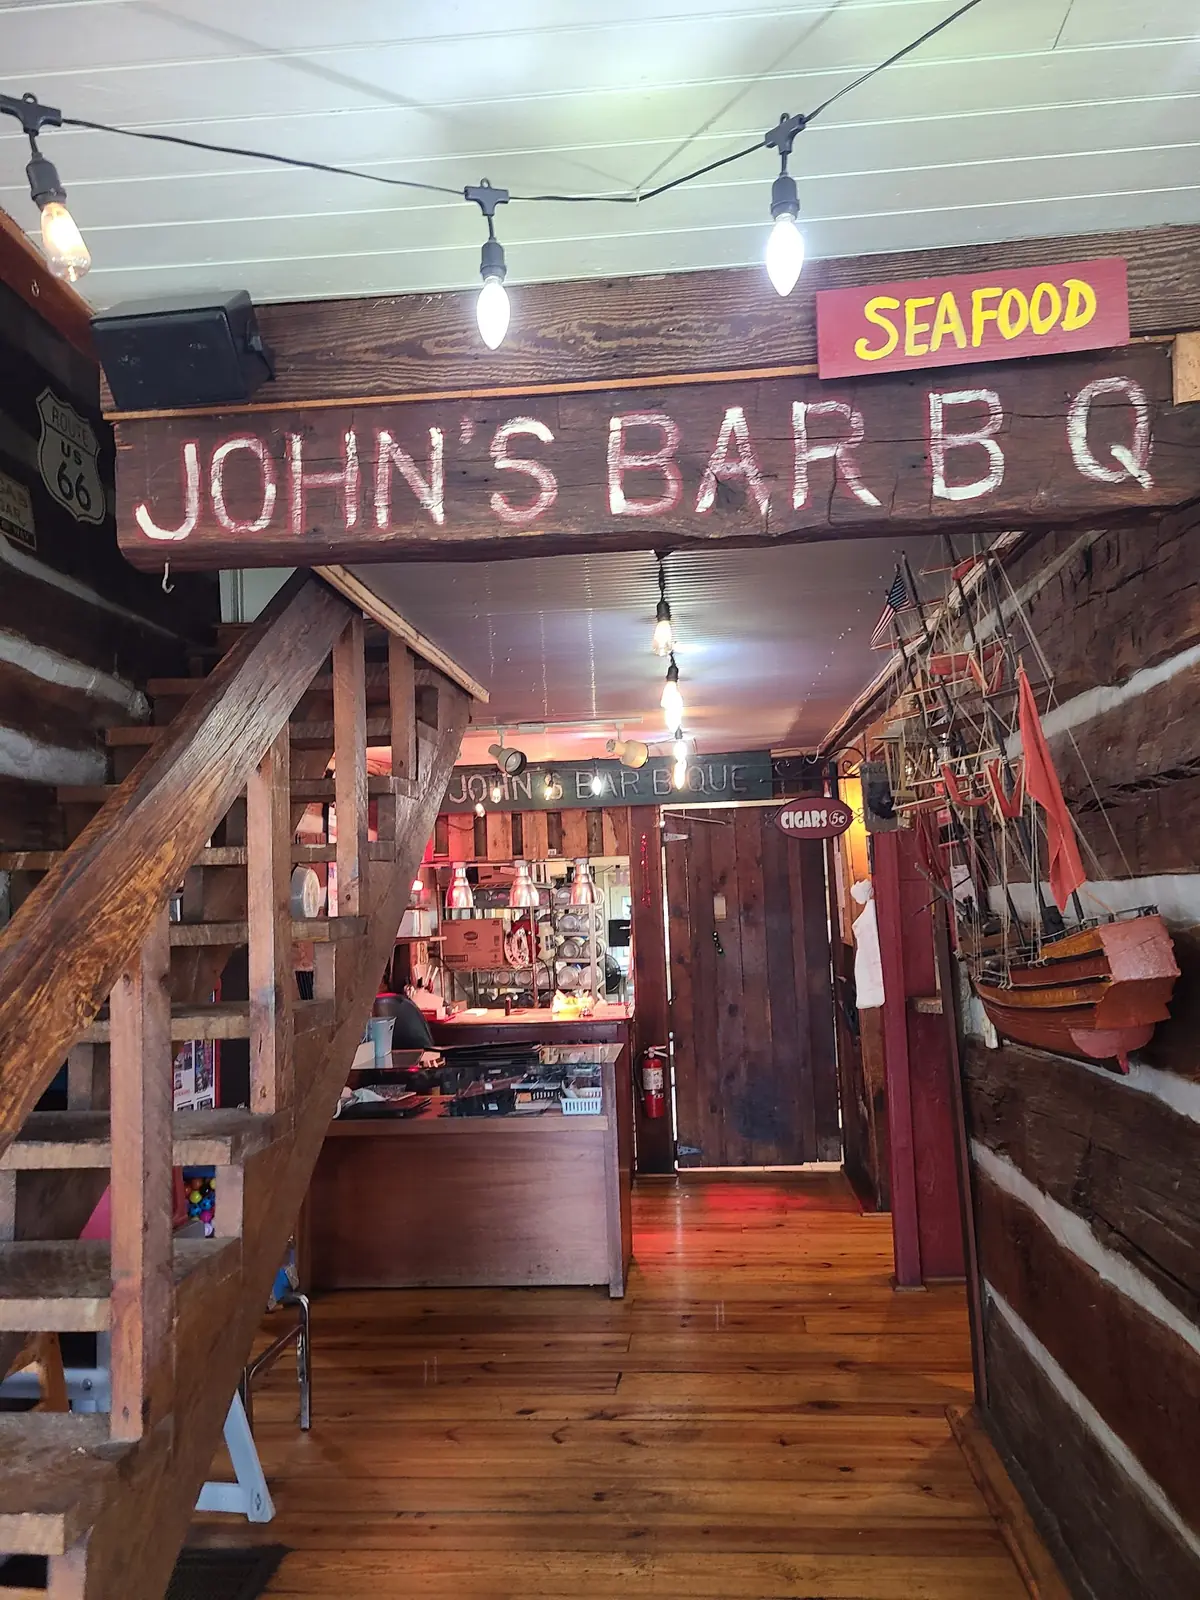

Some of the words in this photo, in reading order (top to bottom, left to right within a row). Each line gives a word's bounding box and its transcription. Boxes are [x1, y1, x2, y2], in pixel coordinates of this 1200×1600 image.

[855, 279, 1097, 361] SEAFOOD
[52, 406, 89, 447] ROUTE
[61, 440, 82, 466] US
[135, 416, 558, 540] JOHN'S
[607, 401, 882, 516] BAR
[929, 388, 1004, 500] B
[1068, 375, 1154, 489] Q
[58, 462, 92, 511] 66
[576, 769, 640, 799] BAR
[781, 809, 828, 829] CIGARS
